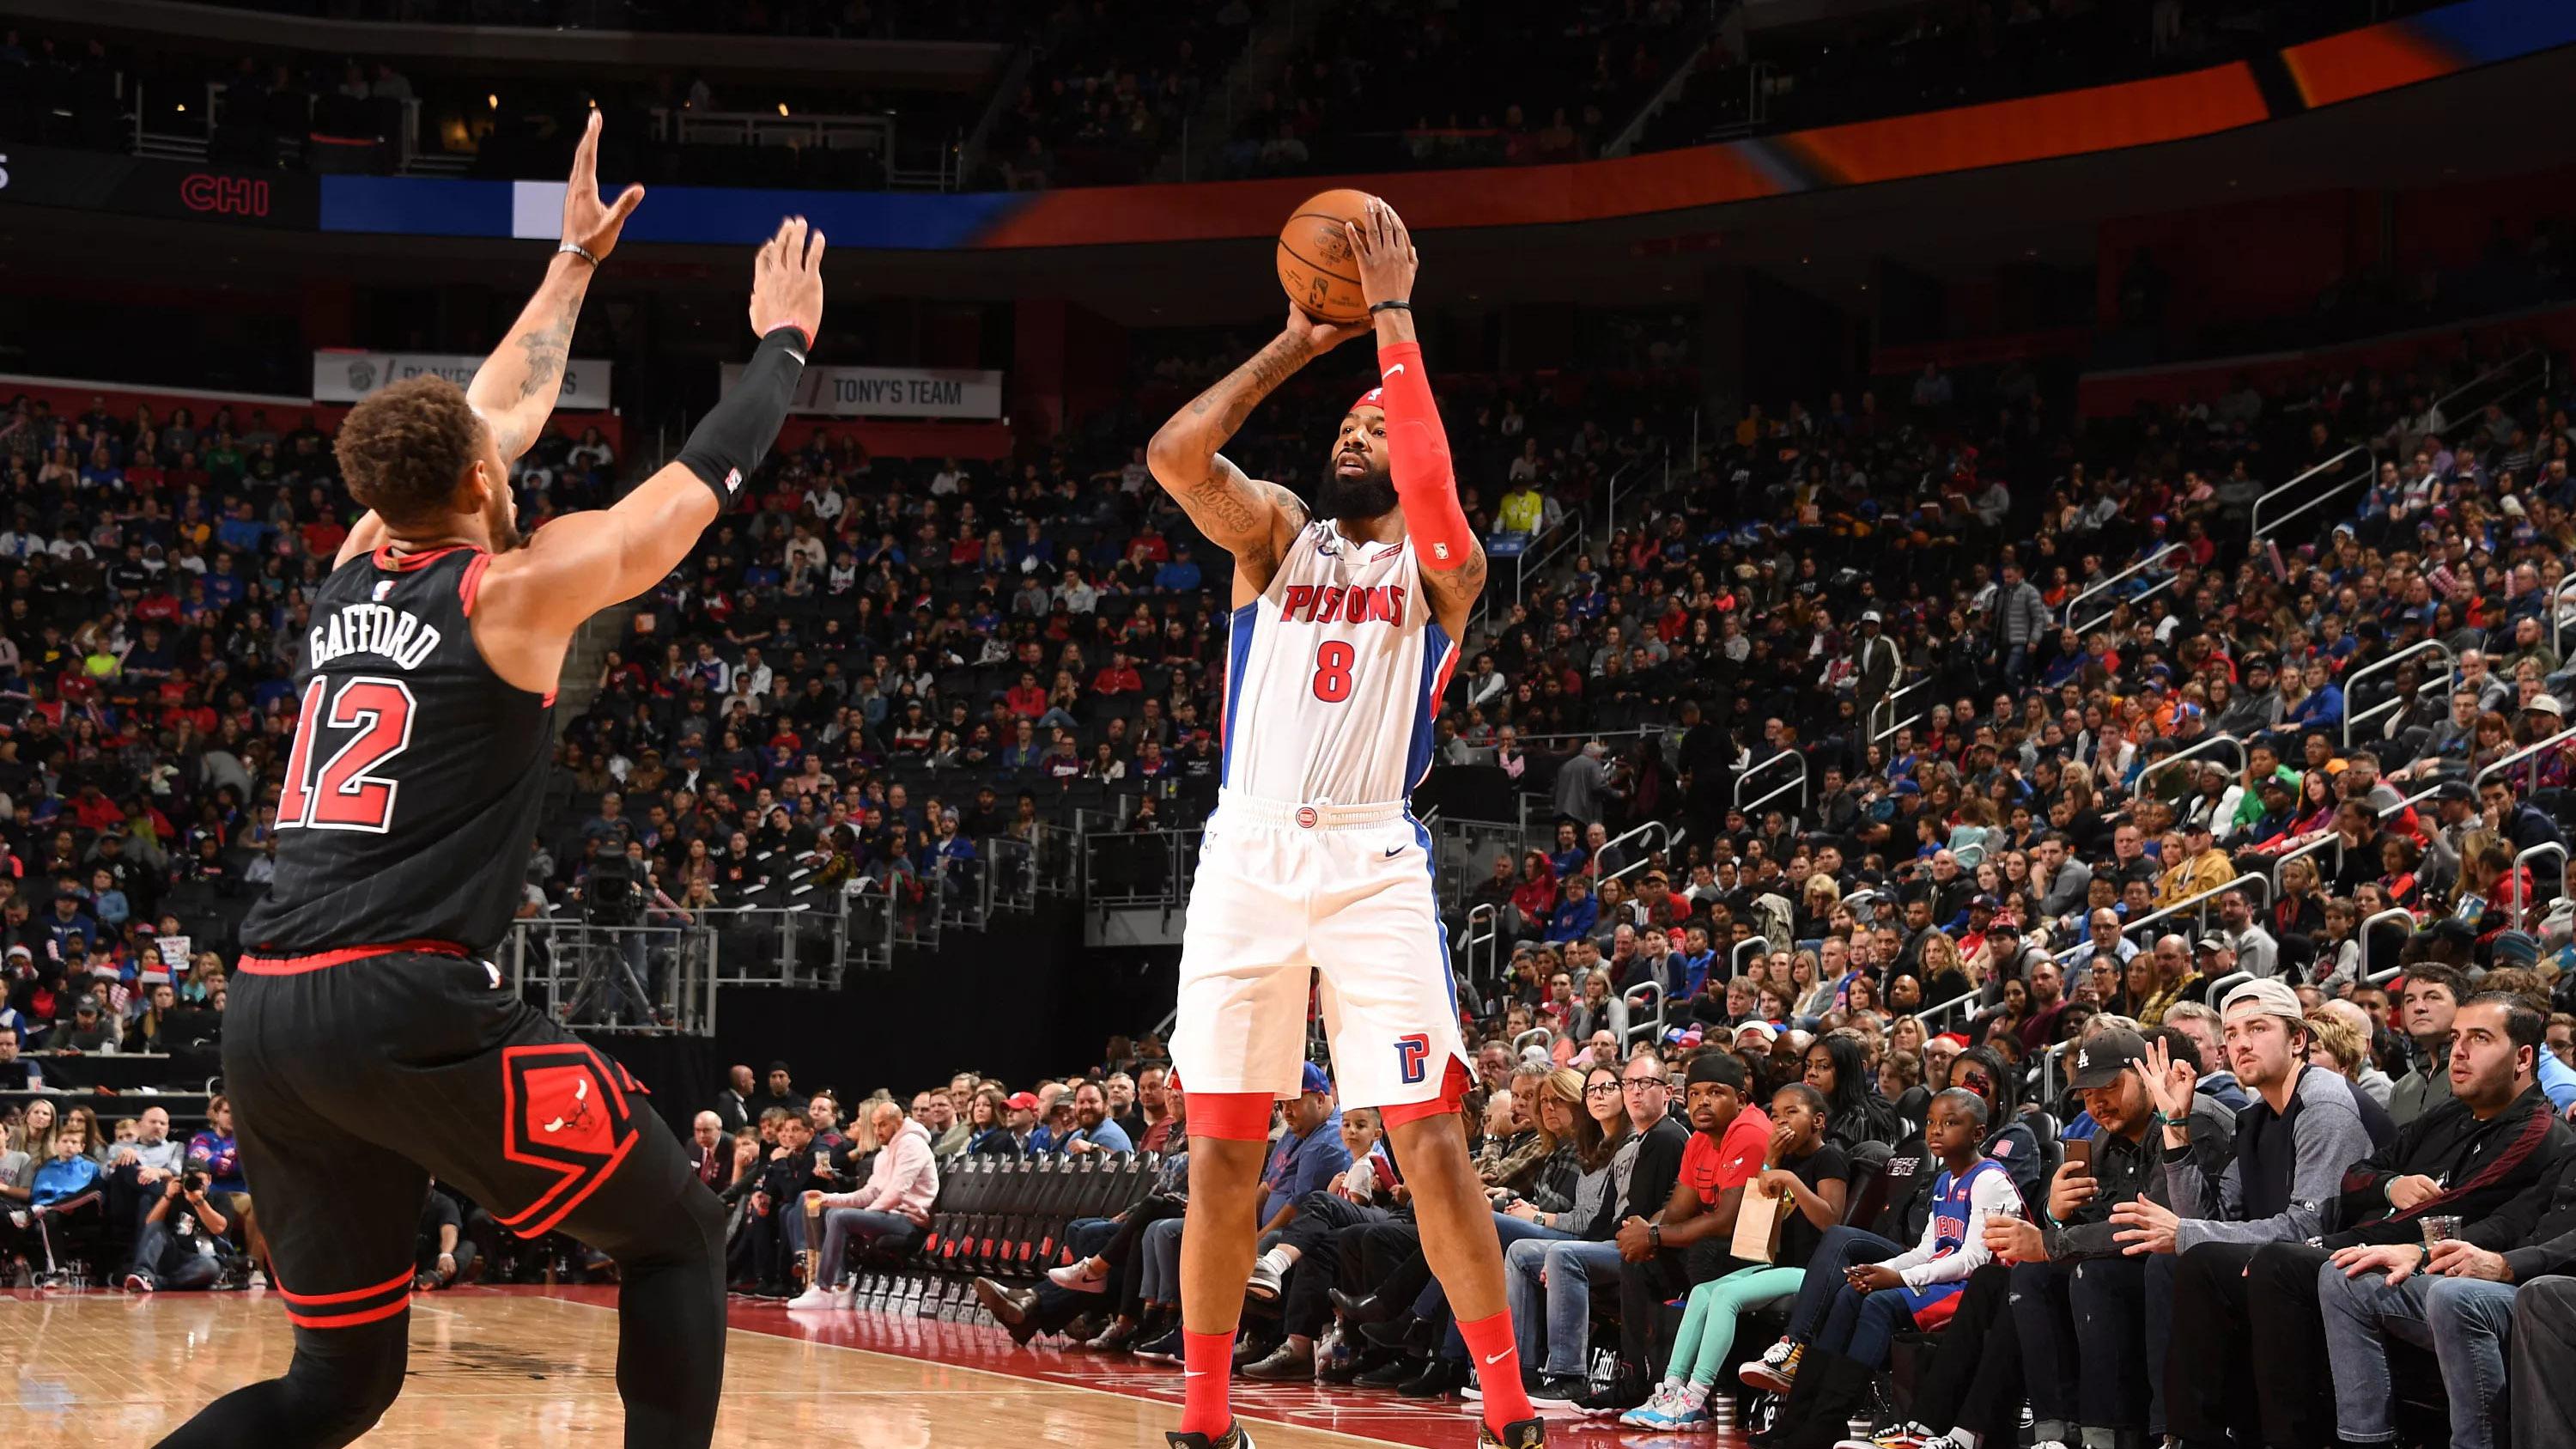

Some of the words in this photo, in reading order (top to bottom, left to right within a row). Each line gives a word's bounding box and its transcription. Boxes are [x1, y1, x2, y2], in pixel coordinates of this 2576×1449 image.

[180, 174, 269, 216] CHI
[834, 378, 902, 404] TONY'S
[908, 381, 962, 405] TEAM
[1279, 584, 1404, 627] PISTONS
[310, 603, 440, 670] GAFFORD
[1312, 640, 1355, 703] 8
[273, 674, 417, 834] 12
